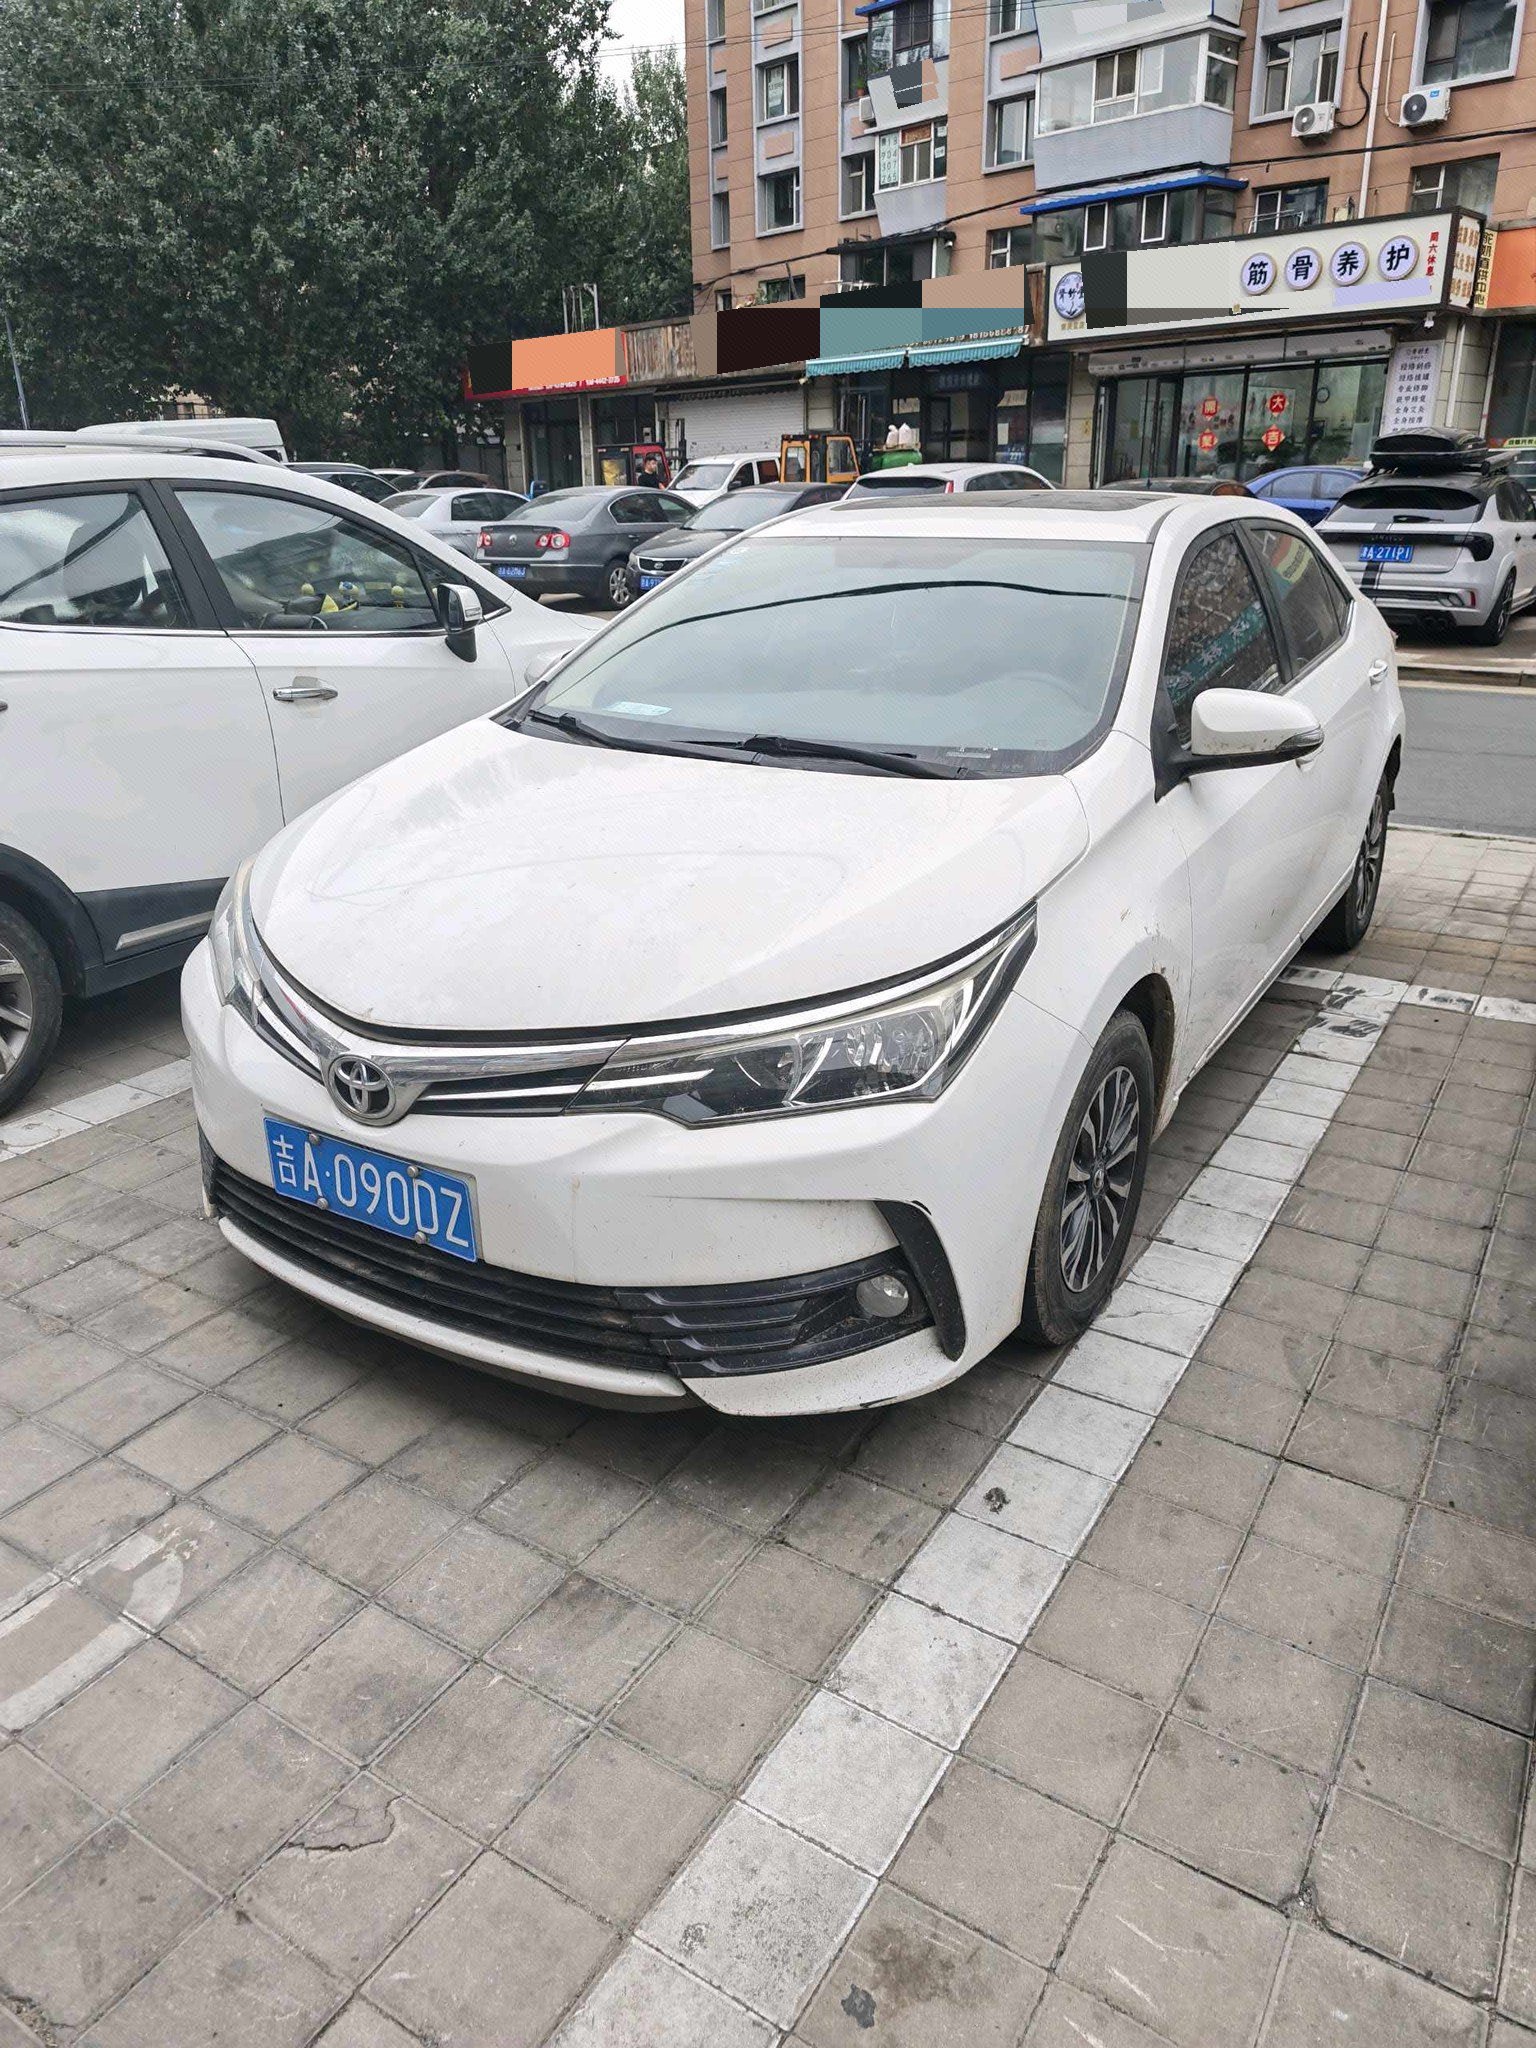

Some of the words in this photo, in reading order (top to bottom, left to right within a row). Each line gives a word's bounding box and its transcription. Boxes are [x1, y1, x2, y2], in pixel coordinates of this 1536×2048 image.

[1247, 243, 1410, 286] 筋骨养护
[1425, 231, 1439, 277] 周六休息
[273, 1134, 469, 1248] 吉A·090DZ
